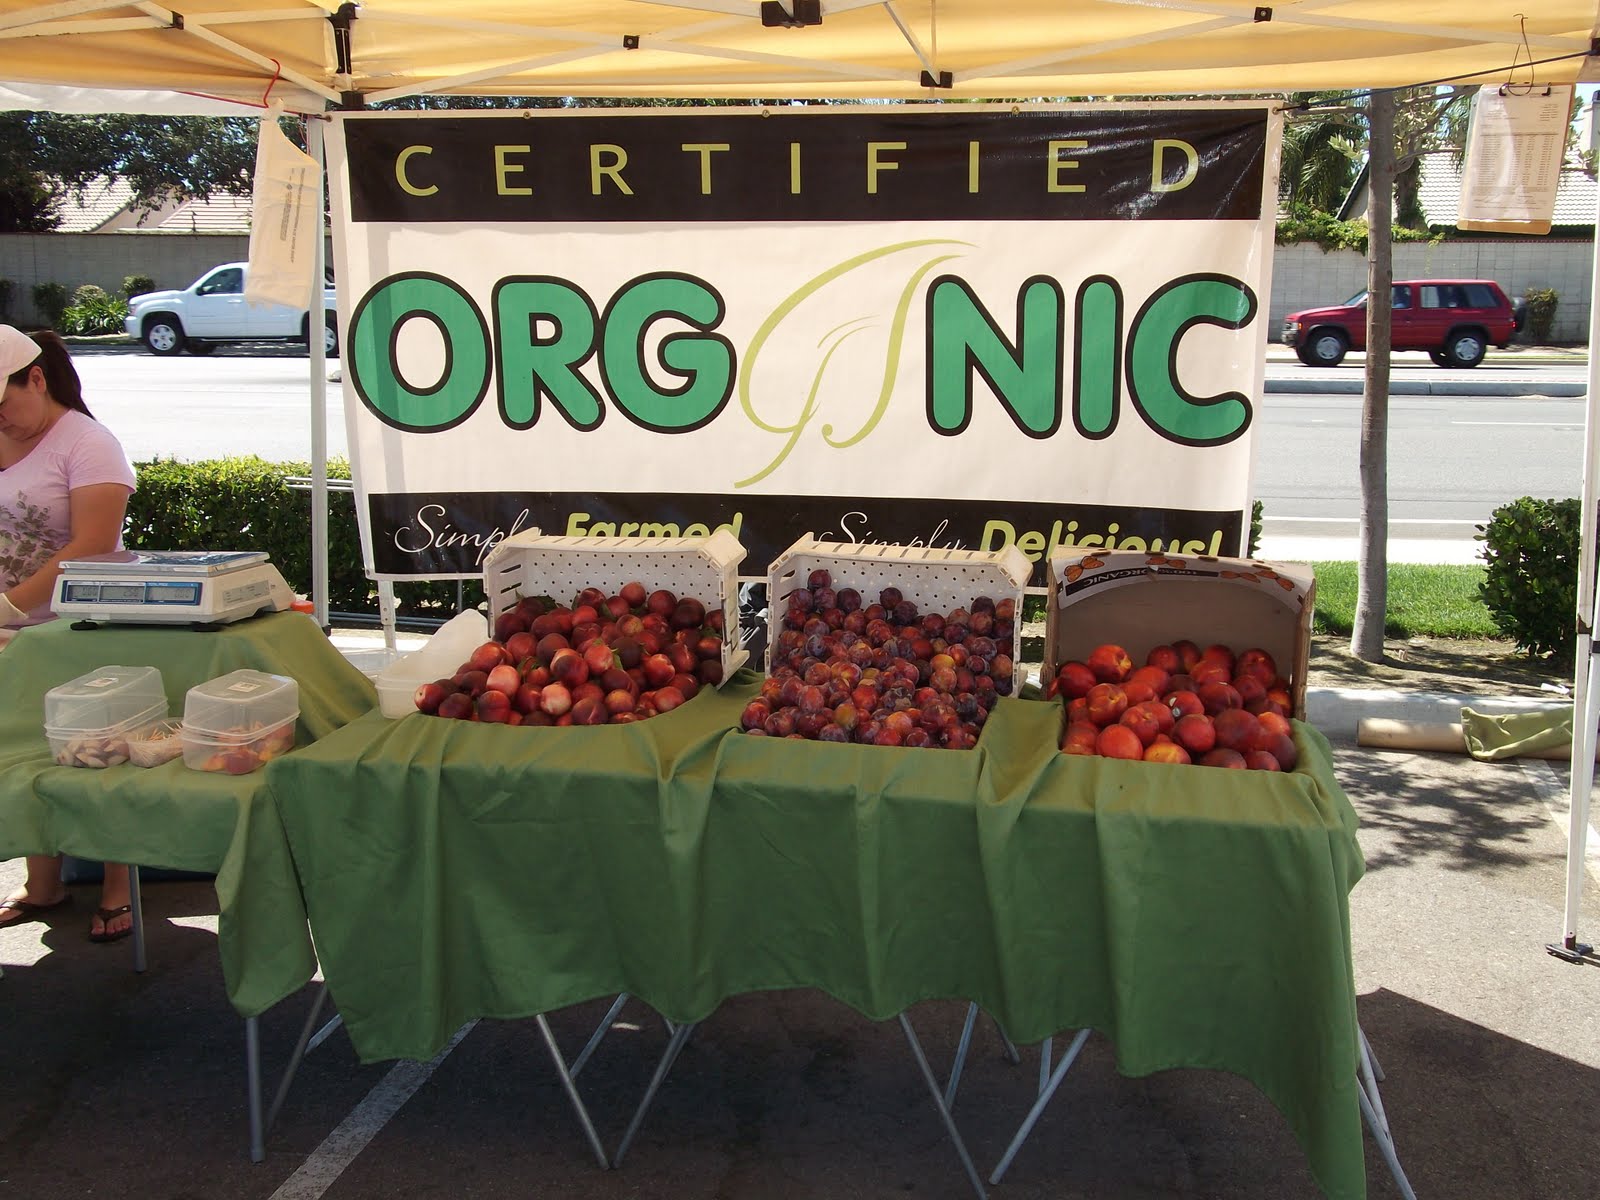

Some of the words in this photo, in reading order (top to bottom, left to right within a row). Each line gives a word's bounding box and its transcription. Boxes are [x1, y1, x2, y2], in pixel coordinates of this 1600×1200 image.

[395, 138, 1199, 197] CERTIFIED
[394, 504, 541, 566] Simpl
[818, 511, 966, 551] Sil
